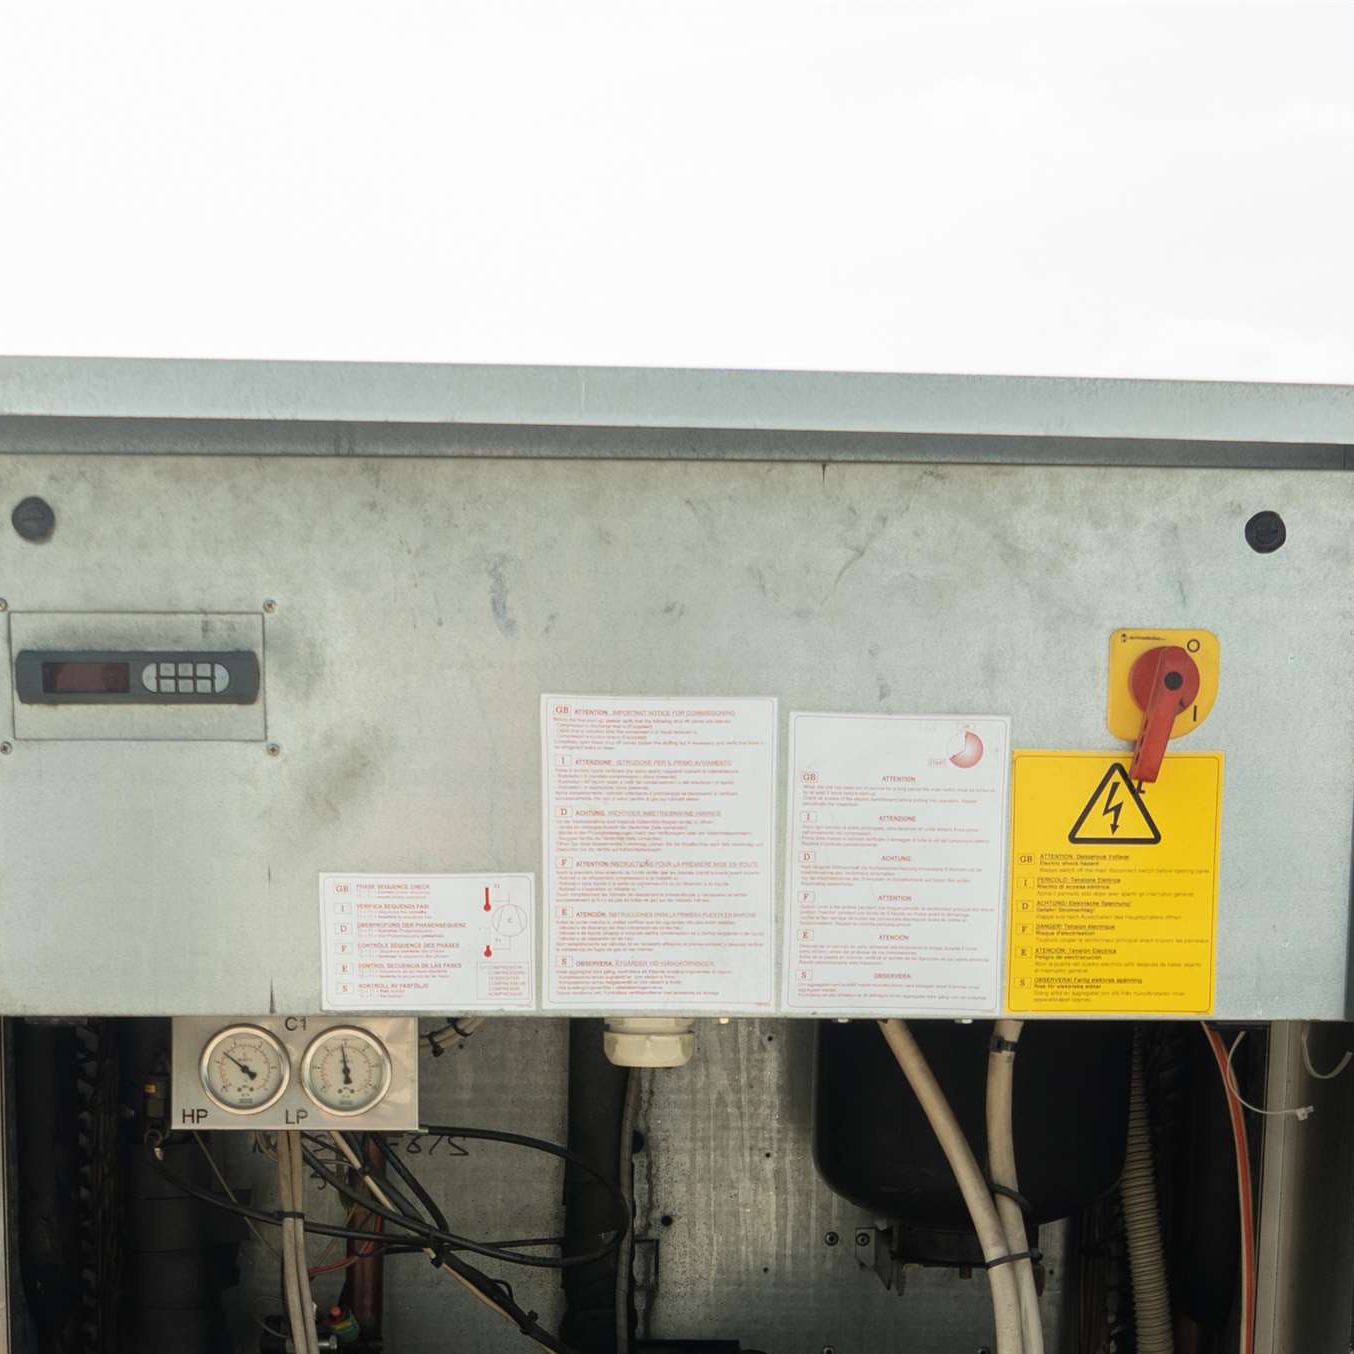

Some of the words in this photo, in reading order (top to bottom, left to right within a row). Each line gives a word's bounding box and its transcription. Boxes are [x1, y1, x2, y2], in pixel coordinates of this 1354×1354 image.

[803, 773, 816, 782] GB
[284, 1016, 307, 1031] C1
[182, 1108, 208, 1124] HP
[285, 1109, 308, 1125] LP
